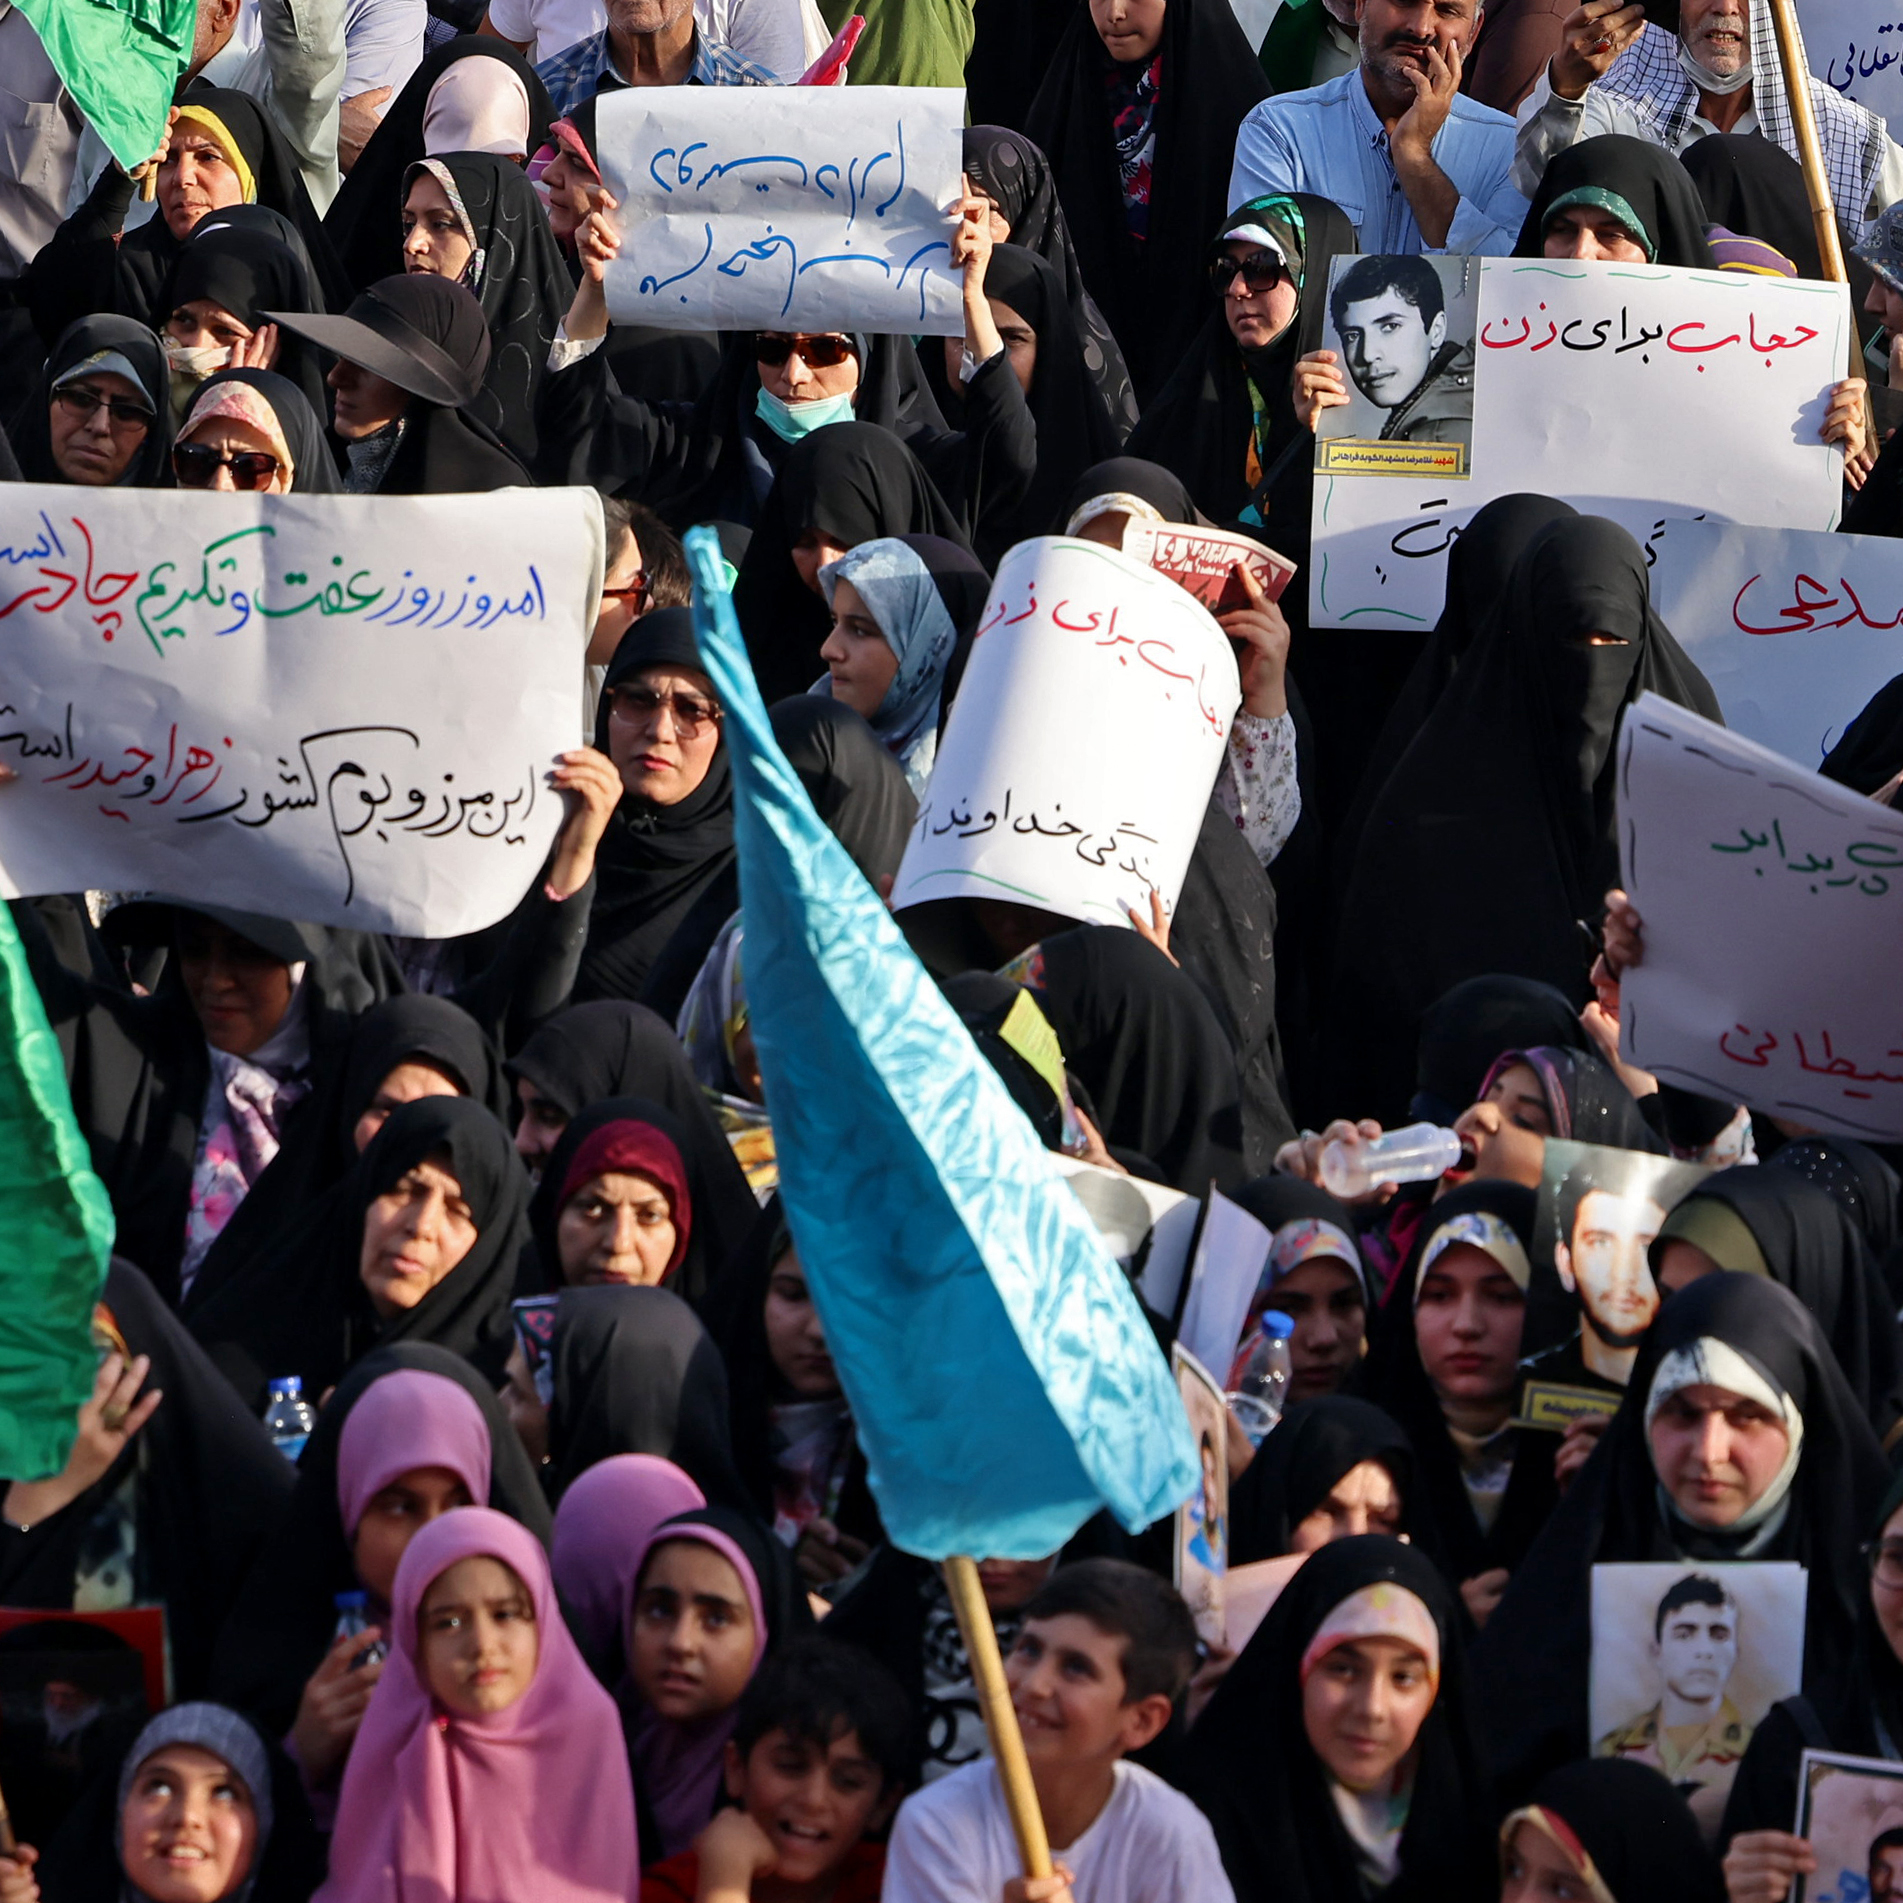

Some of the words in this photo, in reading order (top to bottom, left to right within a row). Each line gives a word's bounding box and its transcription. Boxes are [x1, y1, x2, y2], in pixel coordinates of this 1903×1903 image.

[649, 141, 809, 194] دوست
[815, 119, 904, 232] دارم
[639, 222, 713, 304] من
[717, 225, 891, 318] حجاب
[897, 241, 950, 322] را
[1480, 301, 1561, 355] زن
[1559, 306, 1665, 365] برای
[1666, 311, 1819, 374] حجاب
[1433, 455, 1455, 467] شهید
[135, 524, 277, 658] تکریم
[214, 590, 252, 636] و
[254, 555, 387, 621] عفت
[446, 564, 546, 630] امروز
[1050, 599, 1136, 666] برای
[149, 722, 235, 807] زهرا
[177, 724, 421, 828] کشور
[932, 787, 1084, 839] خداوند
